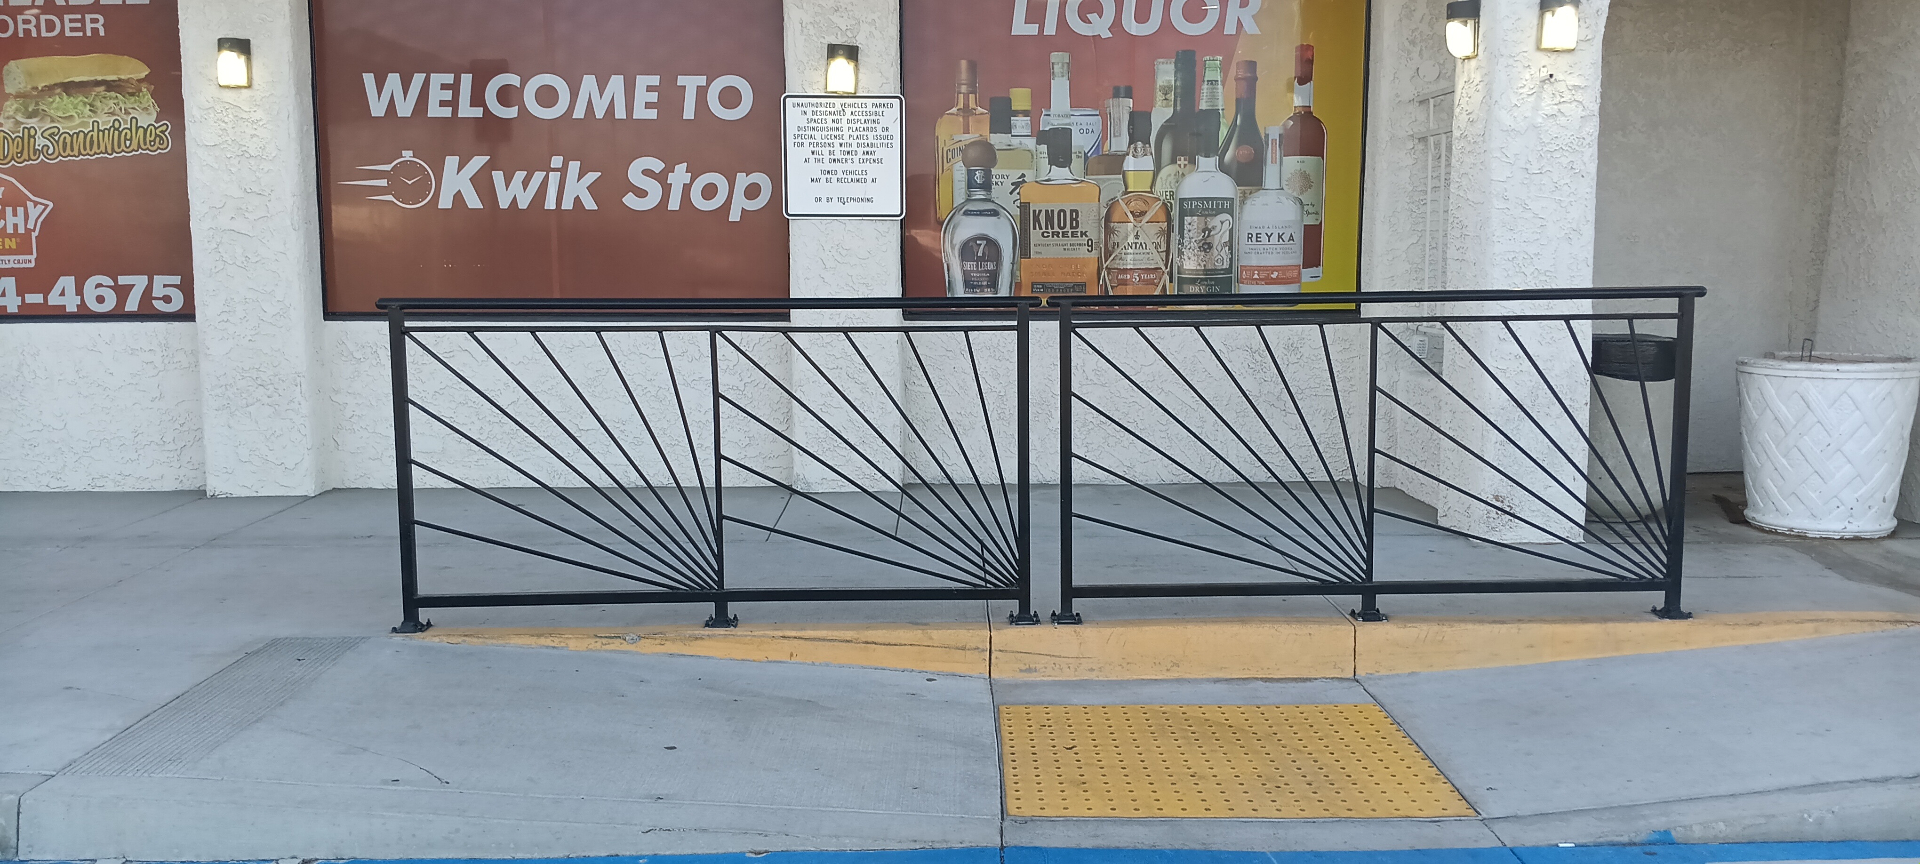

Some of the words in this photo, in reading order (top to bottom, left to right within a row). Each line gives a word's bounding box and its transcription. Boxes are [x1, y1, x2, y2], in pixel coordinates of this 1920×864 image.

[1011, 0, 1262, 39] LIQUOR
[362, 72, 660, 120] WELCOME
[677, 74, 754, 121] TO
[0, 124, 38, 164] Deli
[42, 117, 170, 158] Sandwiches
[437, 155, 602, 210] Kwik
[621, 156, 773, 222] Stop
[1183, 201, 1230, 209] SIPSMITH
[1032, 208, 1080, 231] KNOB
[1041, 230, 1089, 238] CREEK
[1246, 232, 1295, 243] REYKA
[976, 240, 987, 257] 7
[1086, 238, 1094, 253] 9
[1132, 273, 1140, 283] 5
[0, 274, 184, 313] 4-4675
[1189, 285, 1205, 293] DRY
[1206, 285, 1221, 293] GIN
